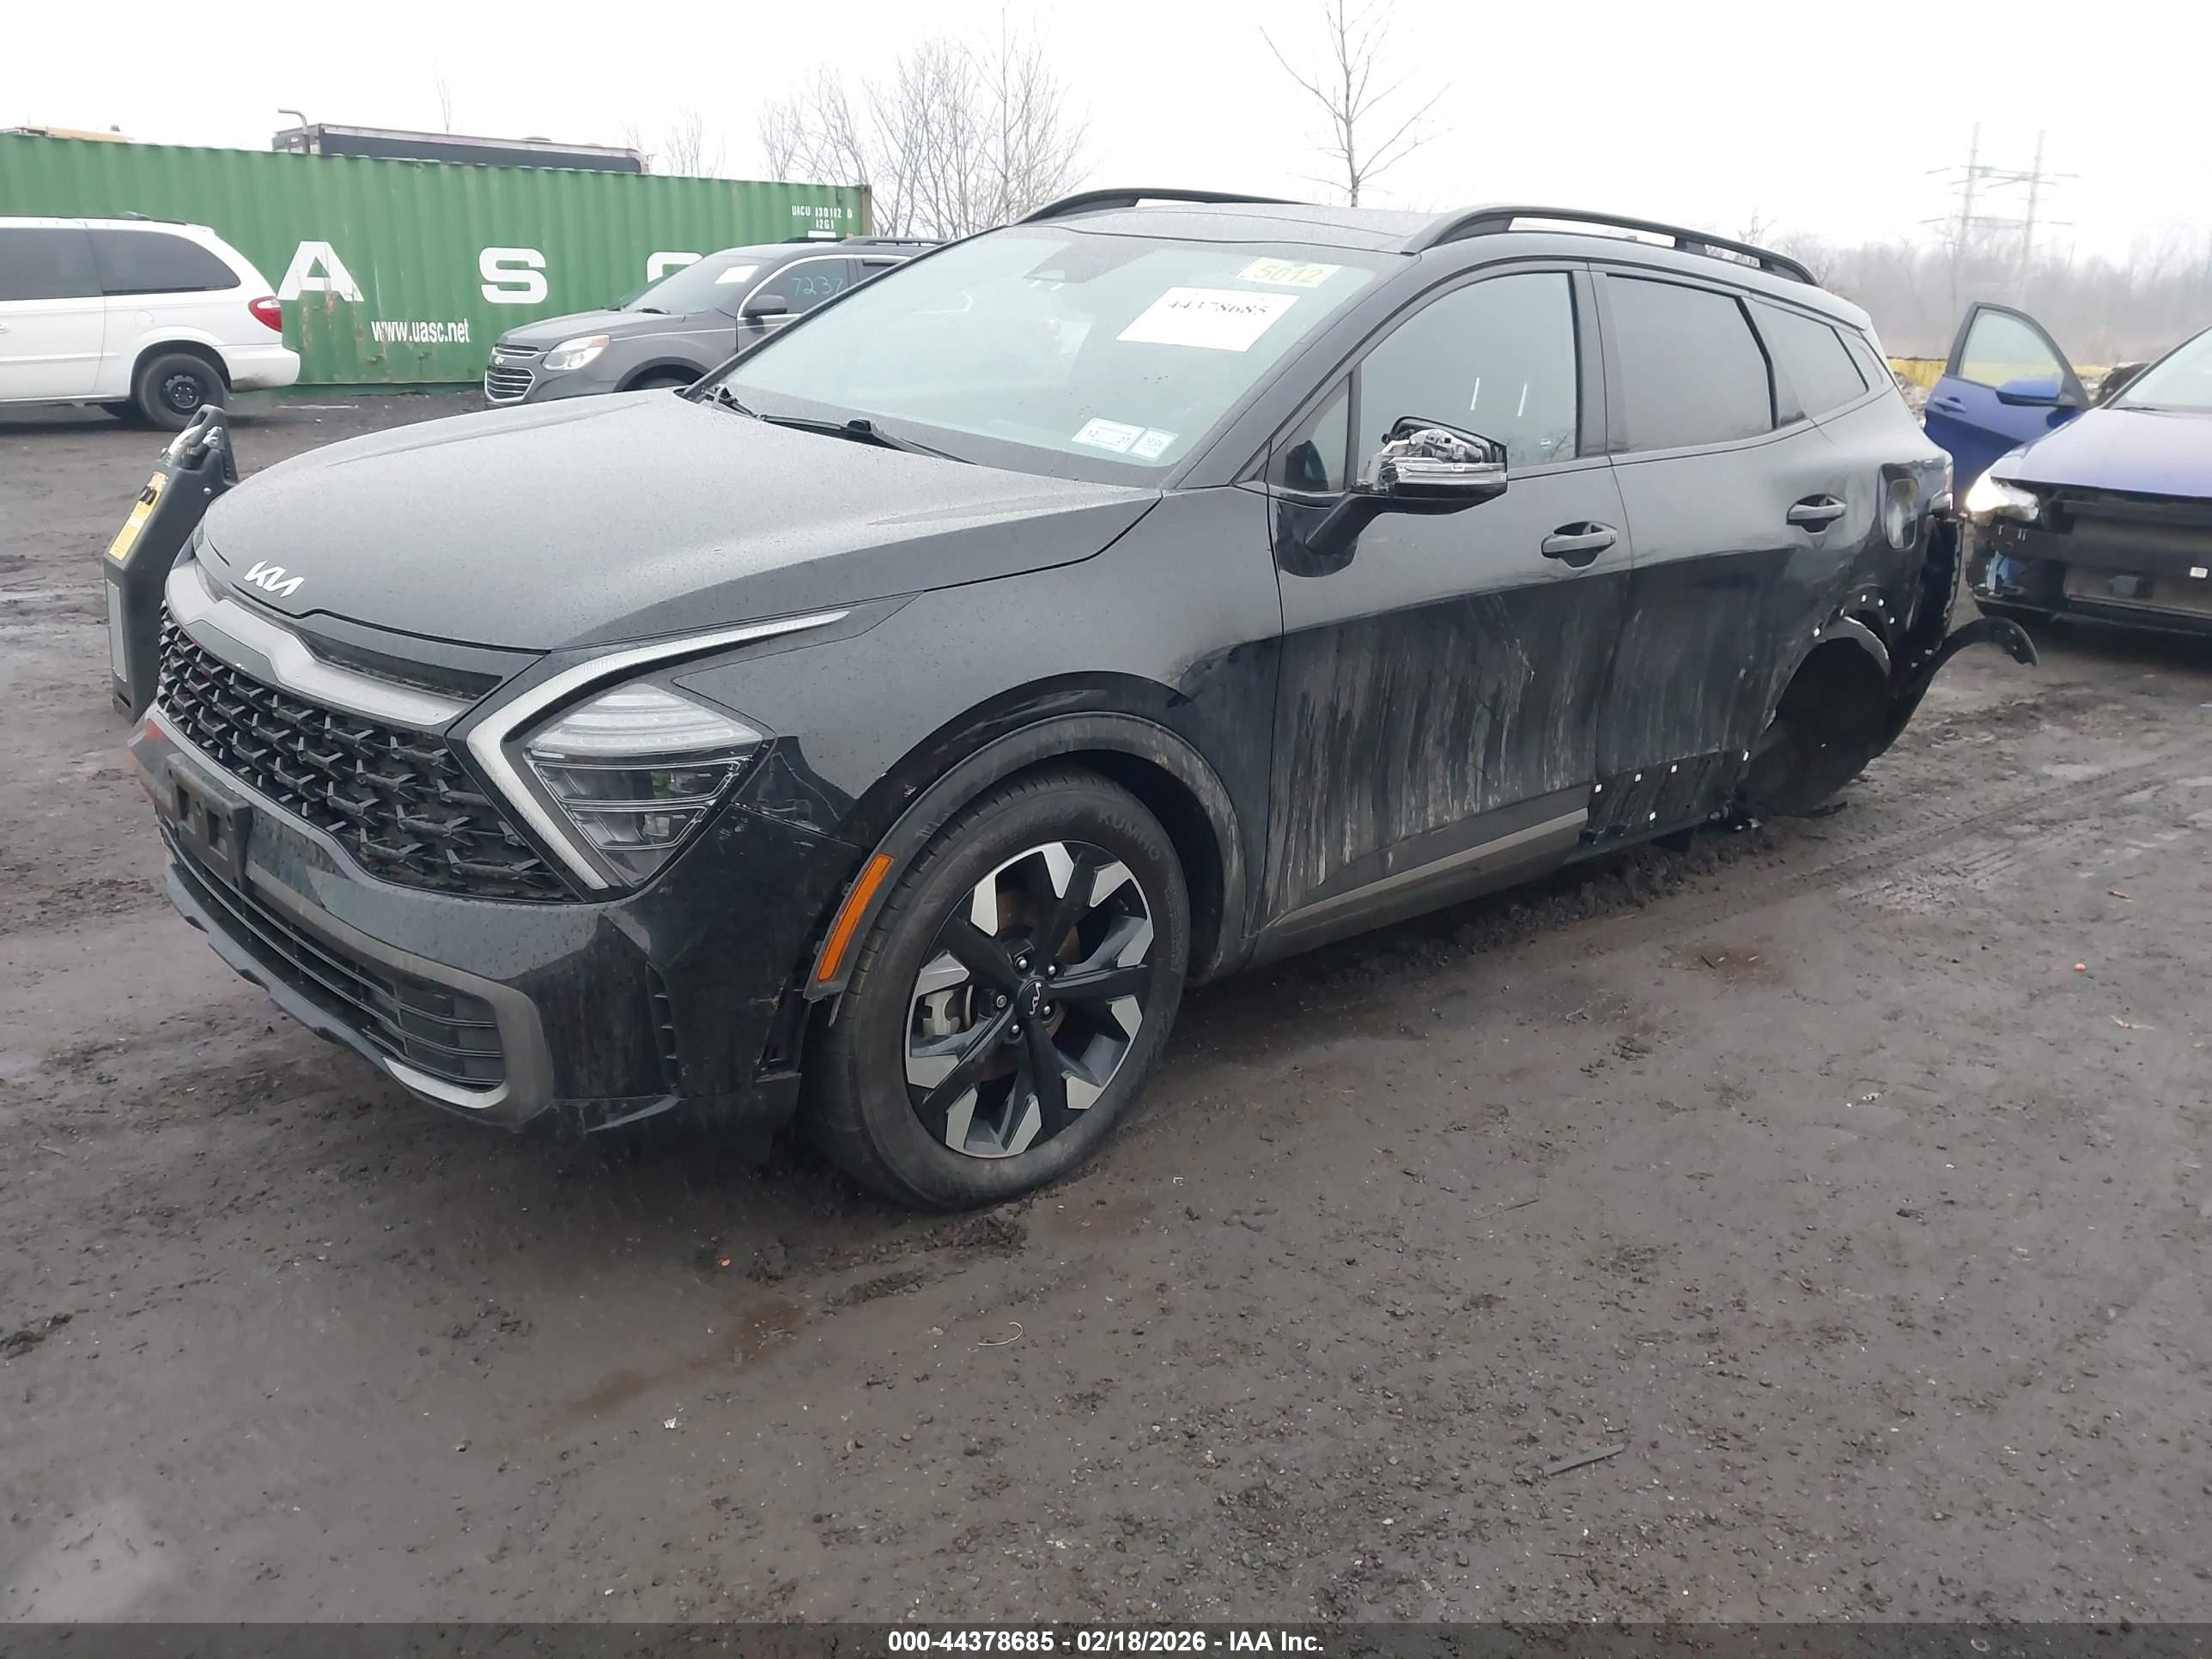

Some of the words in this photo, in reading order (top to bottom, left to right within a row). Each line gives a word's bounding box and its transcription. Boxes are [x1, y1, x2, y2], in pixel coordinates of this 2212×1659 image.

[276, 240, 364, 302] A
[478, 246, 549, 304] S
[792, 276, 843, 298] 7237
[1254, 264, 1322, 283] 5012
[371, 318, 471, 343] www.uasc.net
[244, 560, 305, 598] KIA
[1098, 811, 1161, 860] KUMHO
